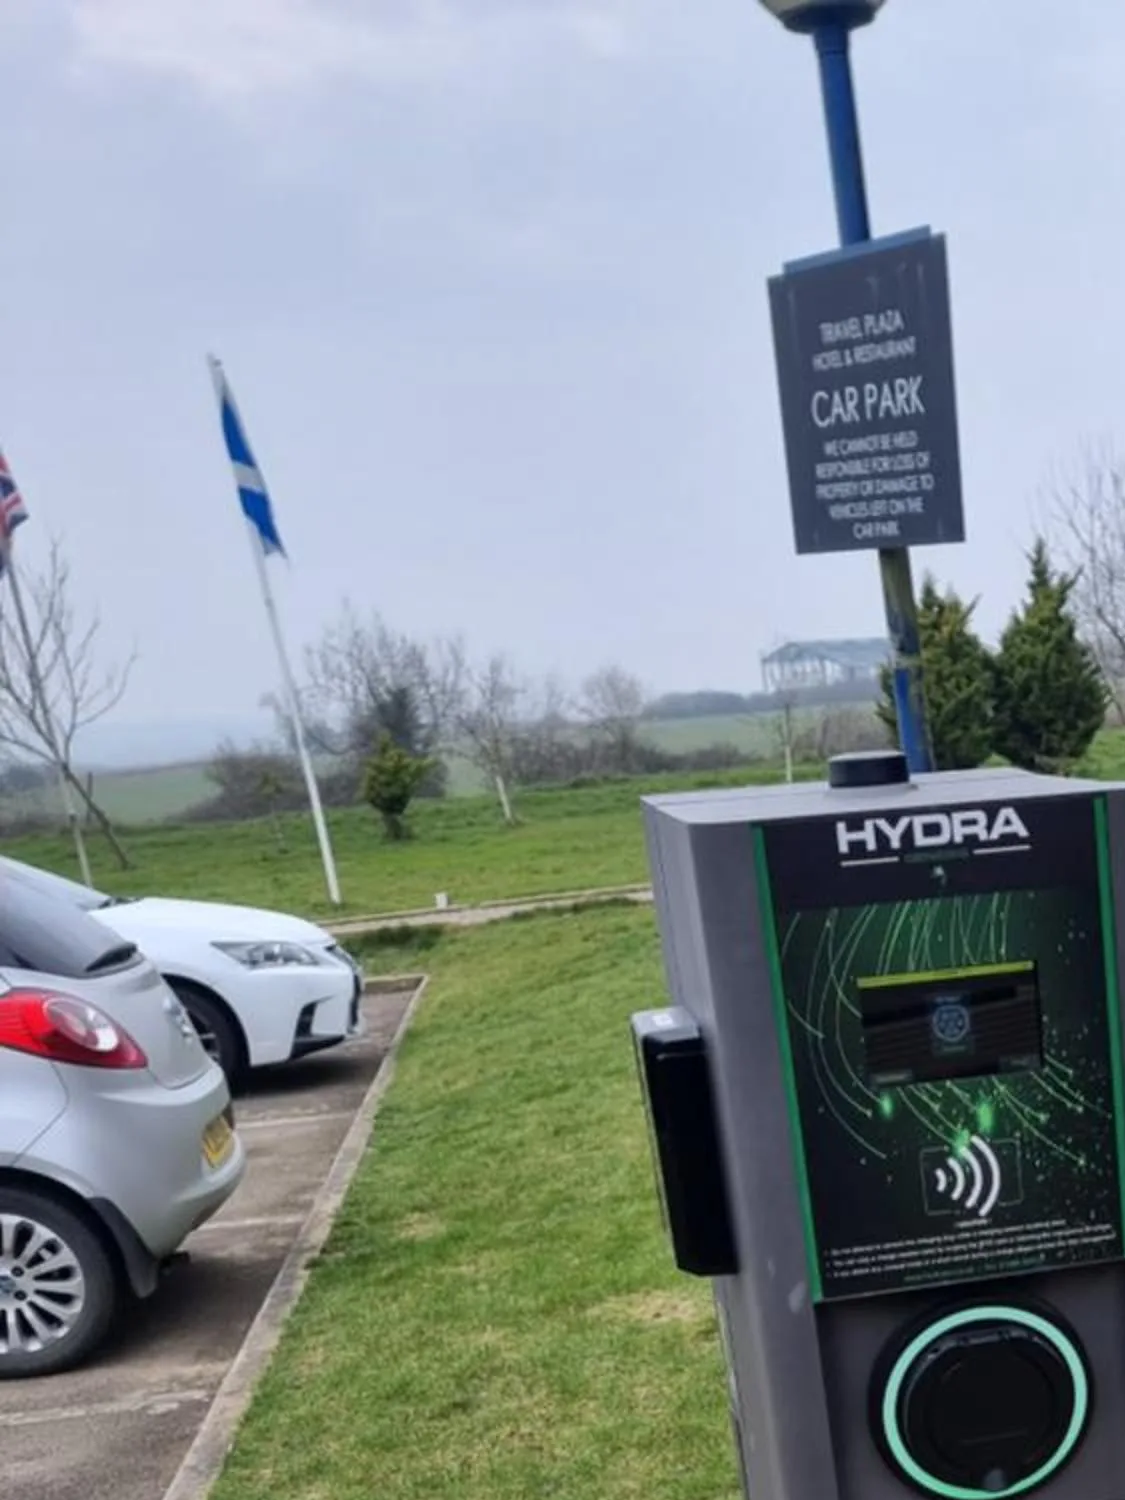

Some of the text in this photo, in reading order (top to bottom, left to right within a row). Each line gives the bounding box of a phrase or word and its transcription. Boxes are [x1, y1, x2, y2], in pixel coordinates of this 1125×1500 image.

[863, 309, 904, 336] PLAZA
[852, 335, 916, 364] RESTAURANT
[811, 375, 925, 428] CAR PARK
[836, 806, 1030, 854] HYDRA
